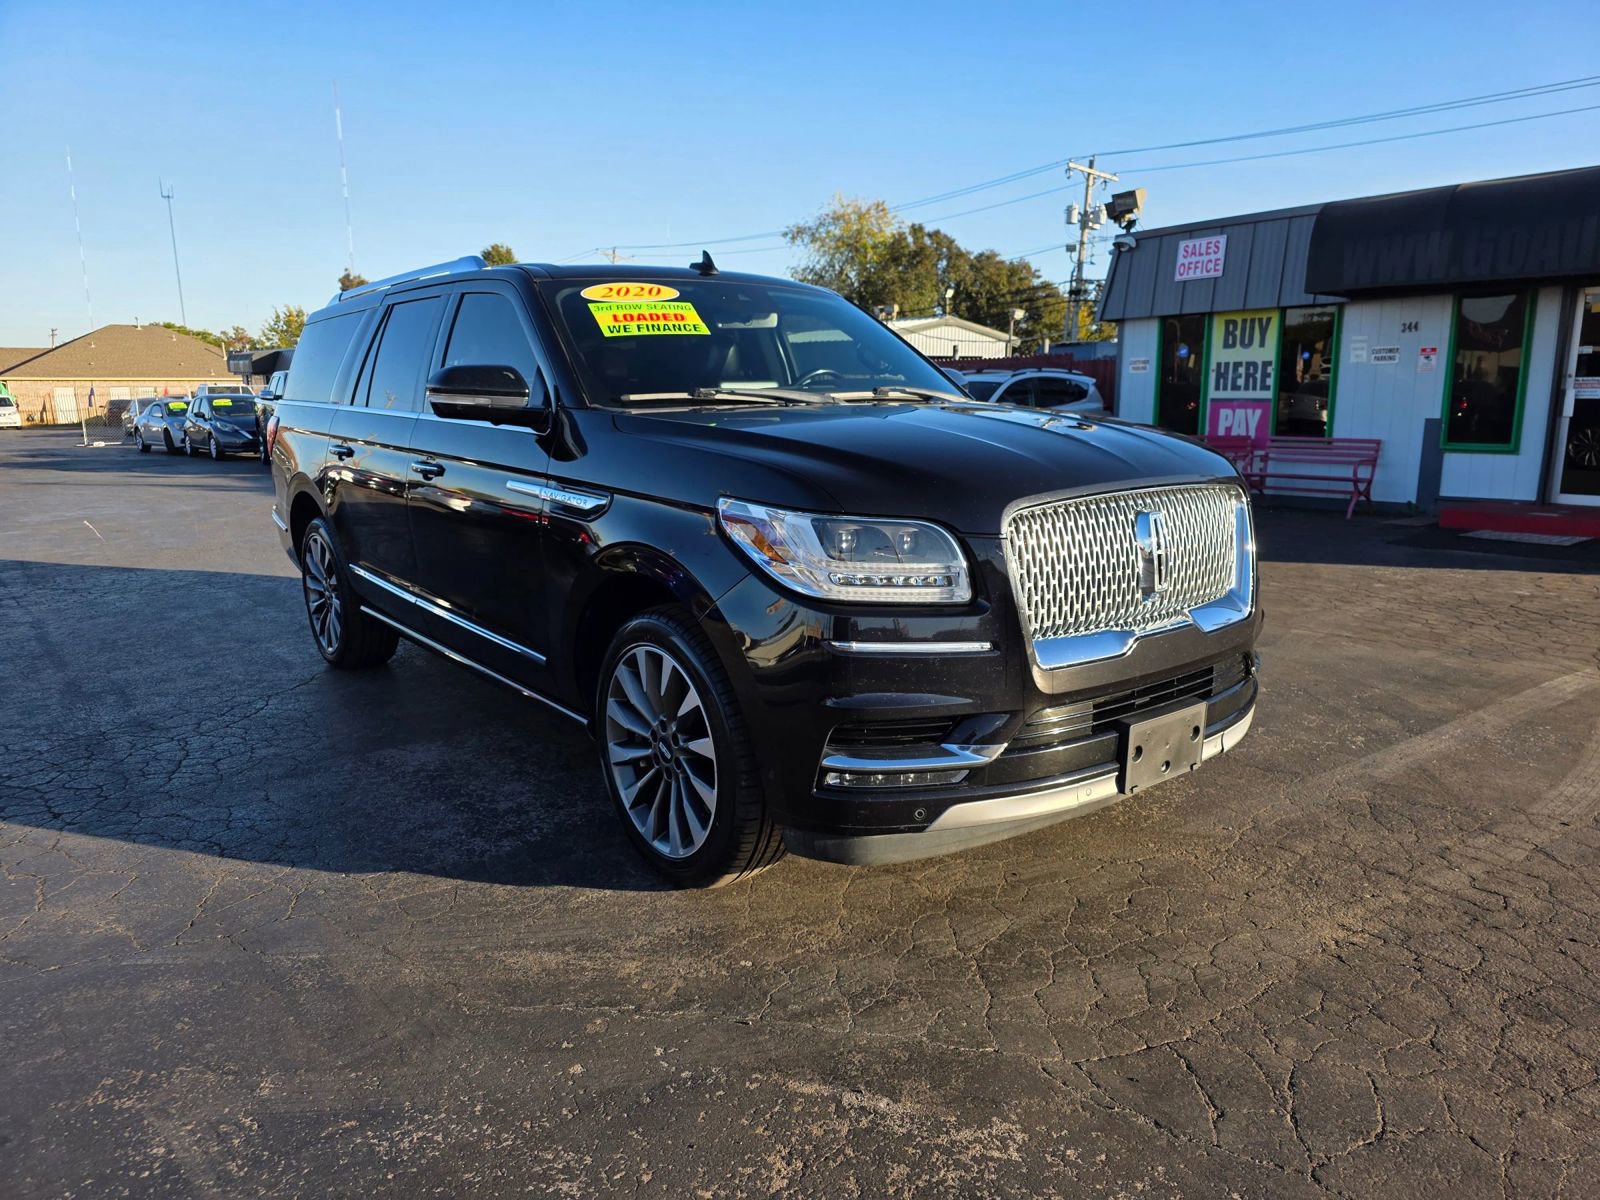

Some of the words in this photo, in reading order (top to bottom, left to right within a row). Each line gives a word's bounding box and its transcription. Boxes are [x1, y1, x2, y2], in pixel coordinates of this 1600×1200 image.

[1182, 240, 1221, 259] SALES
[1178, 258, 1221, 277] OFFICE
[600, 286, 661, 298] 2020
[646, 303, 692, 311] SEATING
[612, 313, 685, 323] LOADED
[607, 324, 633, 334] WE
[637, 323, 701, 333] FINANCE
[1223, 317, 1272, 349] BUY
[1401, 321, 1419, 333] 344
[1214, 360, 1273, 392] HERE
[1217, 408, 1262, 440] PAY
[543, 490, 588, 506] NAVIGATOR
